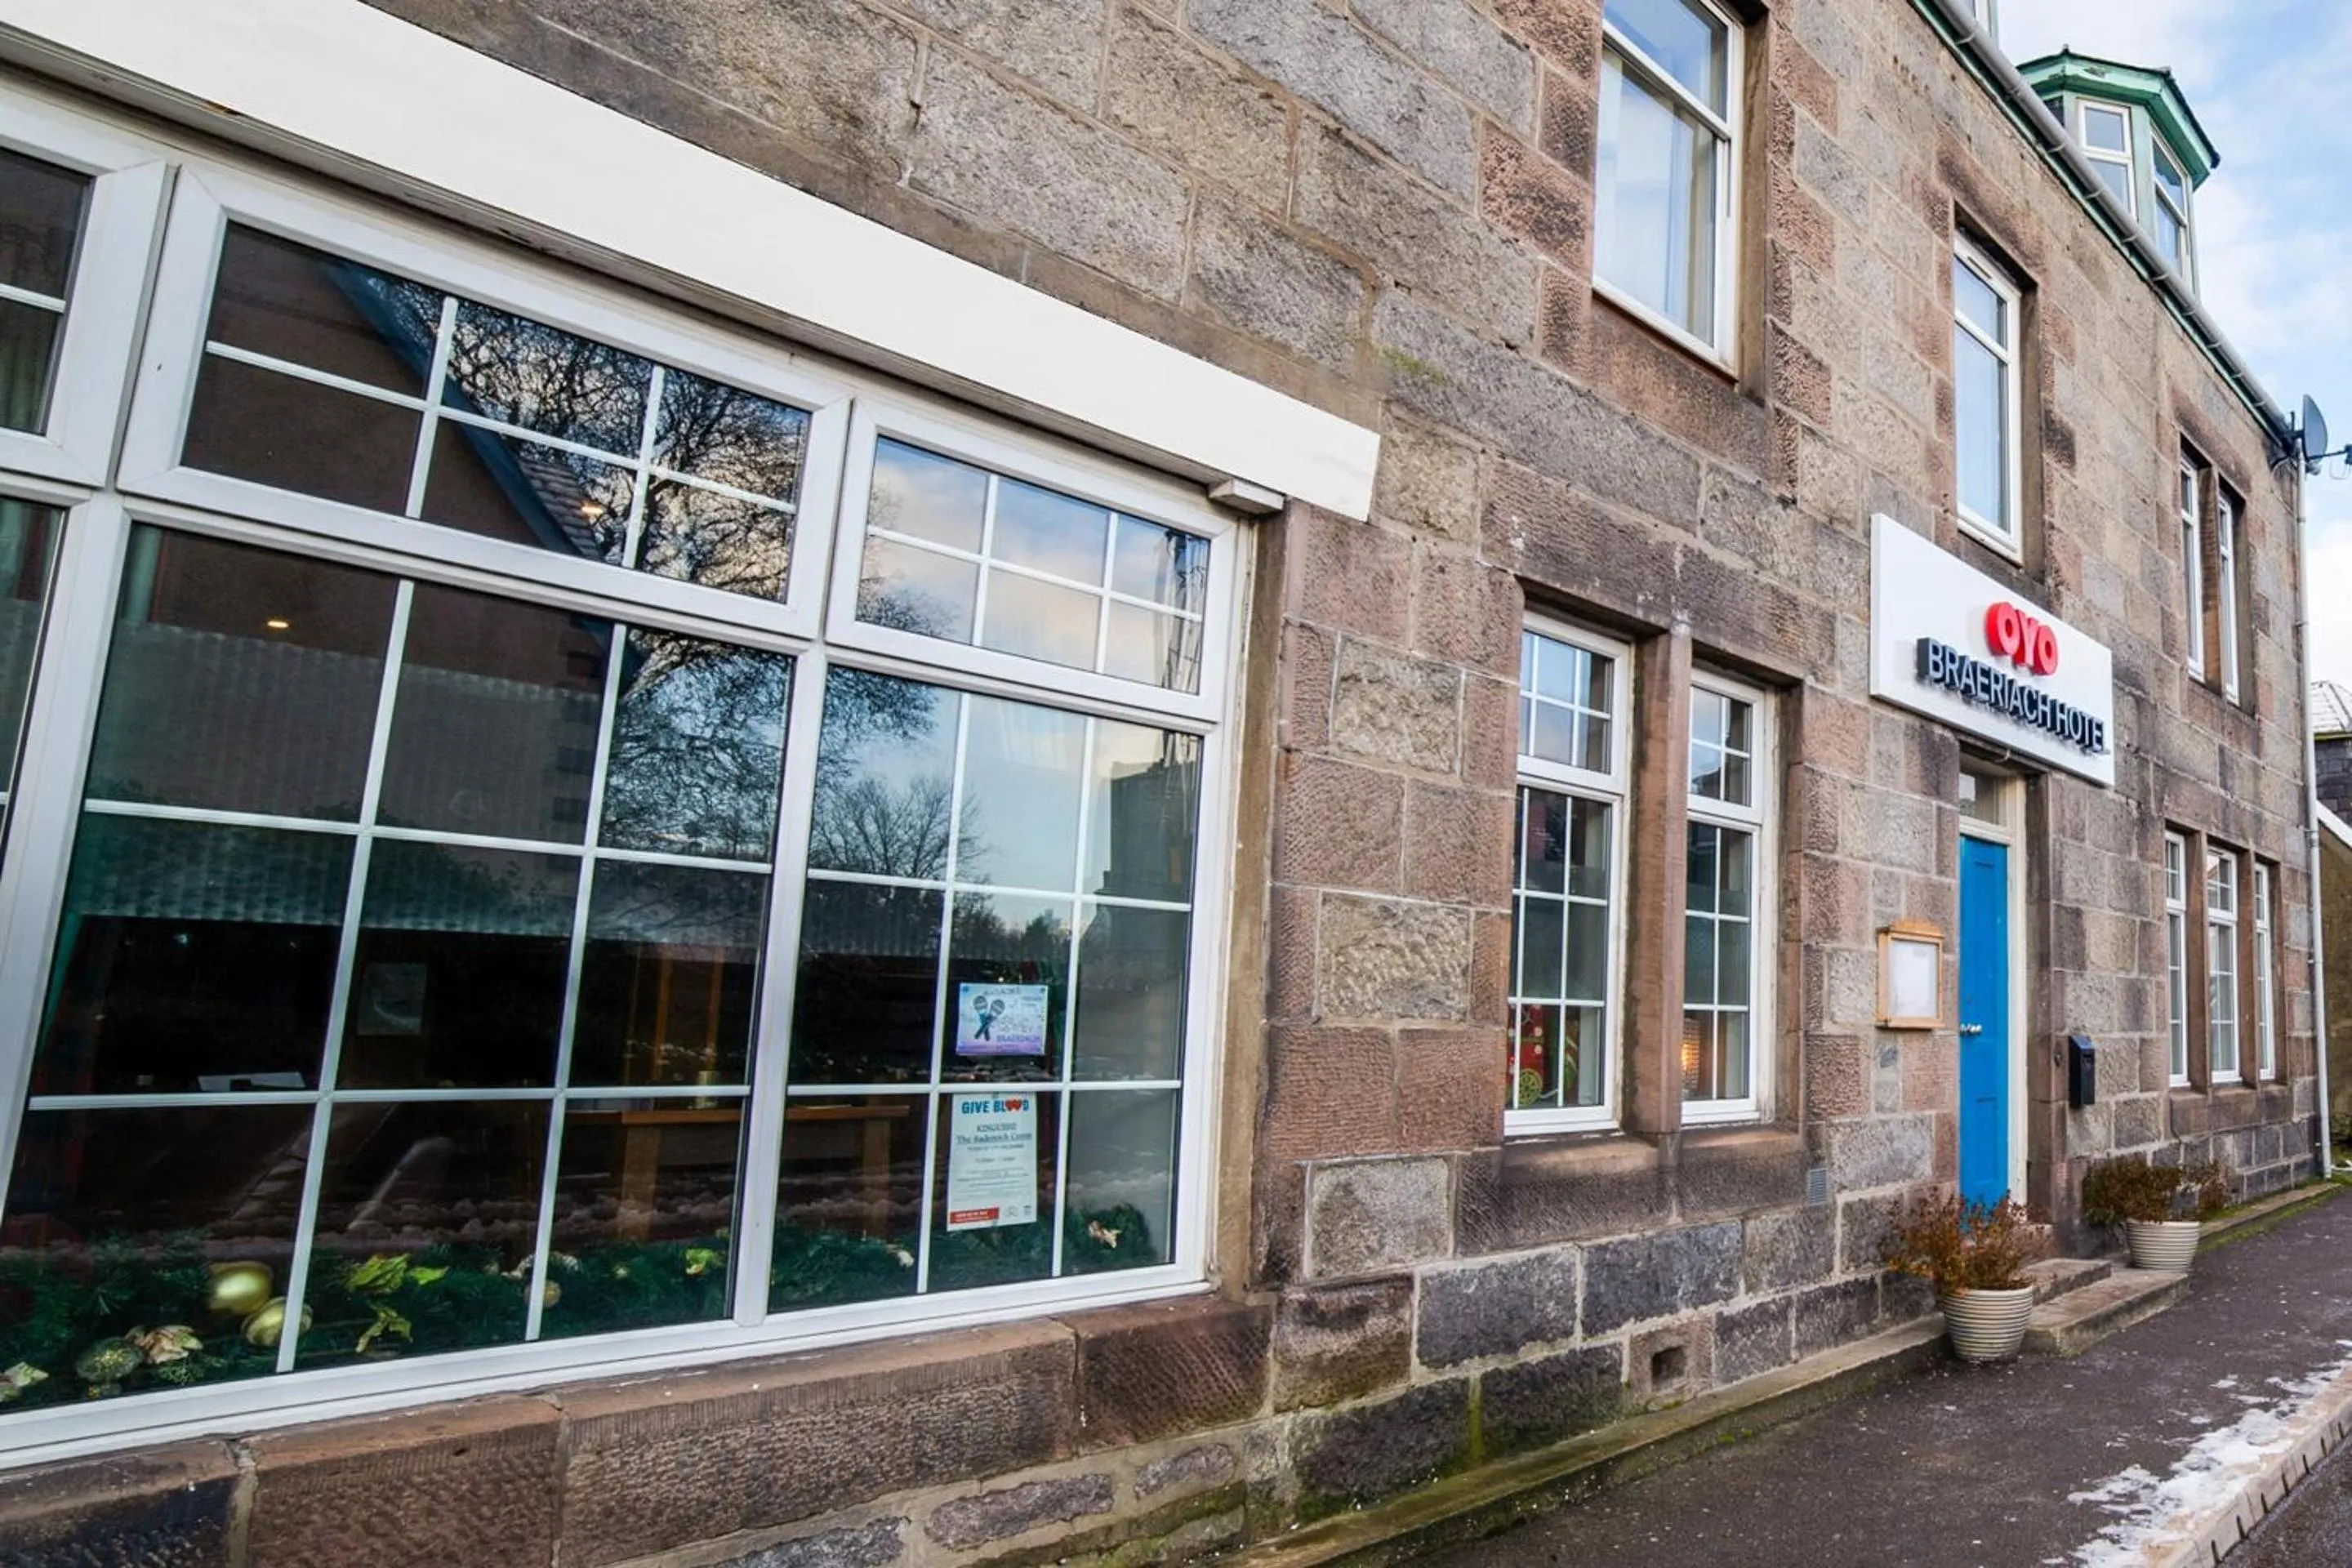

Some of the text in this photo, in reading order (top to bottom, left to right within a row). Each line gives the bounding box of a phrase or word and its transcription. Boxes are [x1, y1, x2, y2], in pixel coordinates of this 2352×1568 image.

[1986, 602, 2058, 675] OYO
[1917, 638, 2050, 732] BRAERIACH
[961, 1098, 1029, 1114] GIVE BLD
